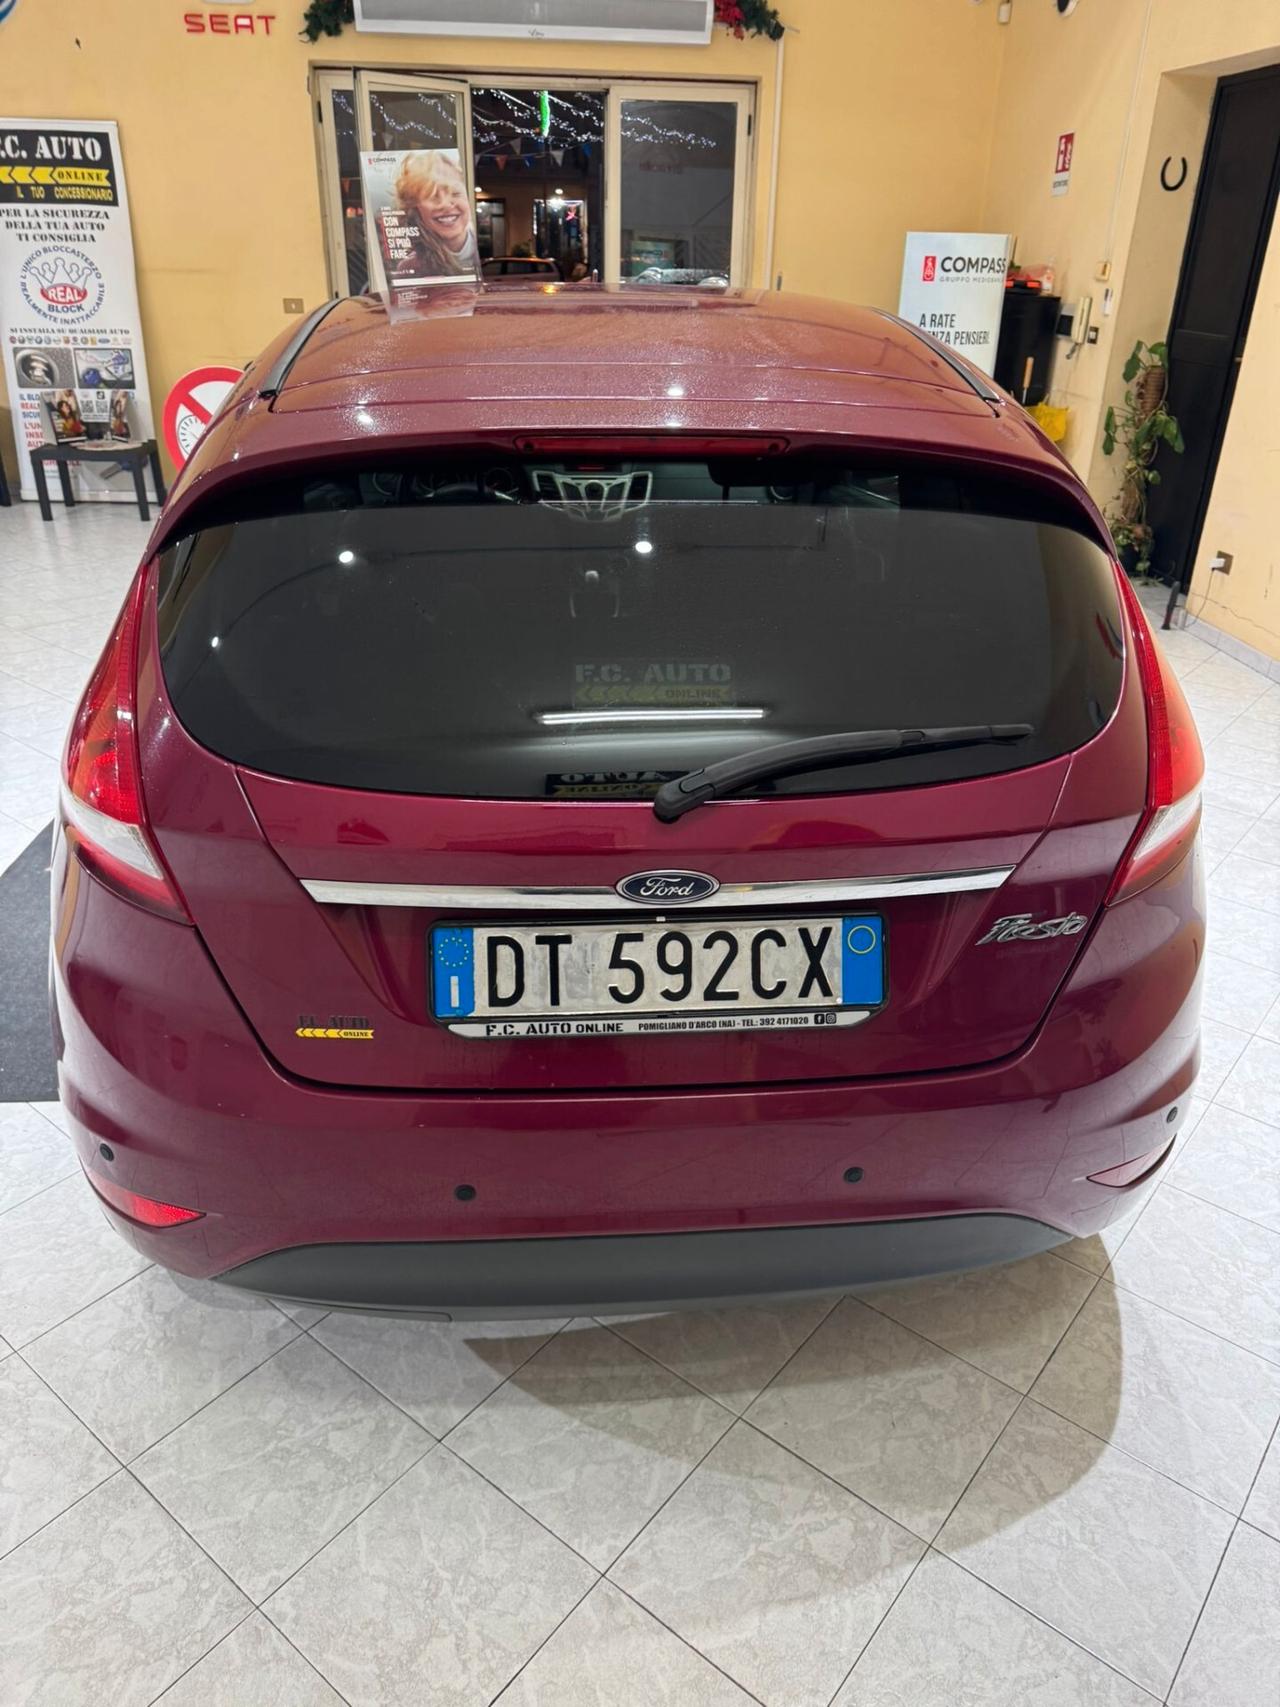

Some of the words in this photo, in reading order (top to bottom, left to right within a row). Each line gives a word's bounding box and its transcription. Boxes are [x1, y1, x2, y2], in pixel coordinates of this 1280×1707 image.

[184, 13, 276, 35] SEAT
[0, 135, 28, 160] .C.
[35, 135, 102, 161] AUTO
[57, 170, 104, 182] ONLINE
[30, 186, 45, 199] TUO
[54, 187, 114, 201] CONCESSIONARIO
[0, 208, 21, 218] PER
[25, 208, 39, 218] LA
[42, 208, 110, 220] SICUREZZA
[383, 217, 399, 226] CON
[5, 221, 41, 231] DELLA
[45, 221, 70, 231] TUA
[72, 222, 105, 231] AUTO
[385, 227, 420, 238] COMPASS
[16, 233, 29, 242] TI
[32, 233, 97, 243] CONSIGLIA
[388, 239, 396, 248] SI
[390, 249, 409, 259] FARE
[42, 245, 102, 279] BLOCCASTERZO
[940, 256, 1006, 273] COMPASS
[48, 287, 82, 303] REAL
[20, 281, 58, 324] REALMENTE
[60, 282, 105, 325] INATTACCABILE
[47, 304, 85, 314] BLOCK
[919, 313, 926, 327] A
[930, 313, 956, 328] RATE
[954, 330, 990, 345] PENSIERI
[576, 663, 630, 683] F.C.
[644, 663, 731, 682] AUTO
[640, 876, 694, 896] Ford
[975, 911, 1088, 946] Fiesta
[487, 934, 572, 1007] DT
[608, 926, 834, 1004] 592CX
[486, 1024, 521, 1036] F.C.
[526, 1023, 571, 1035] AUTO
[576, 1022, 624, 1033] ONLINE
[638, 1022, 687, 1031] POMIGLIANO
[689, 1021, 717, 1029] D'ARCO
[718, 1020, 736, 1029] (NA)
[759, 1018, 776, 1027] 392
[776, 1016, 809, 1026] 4171020
